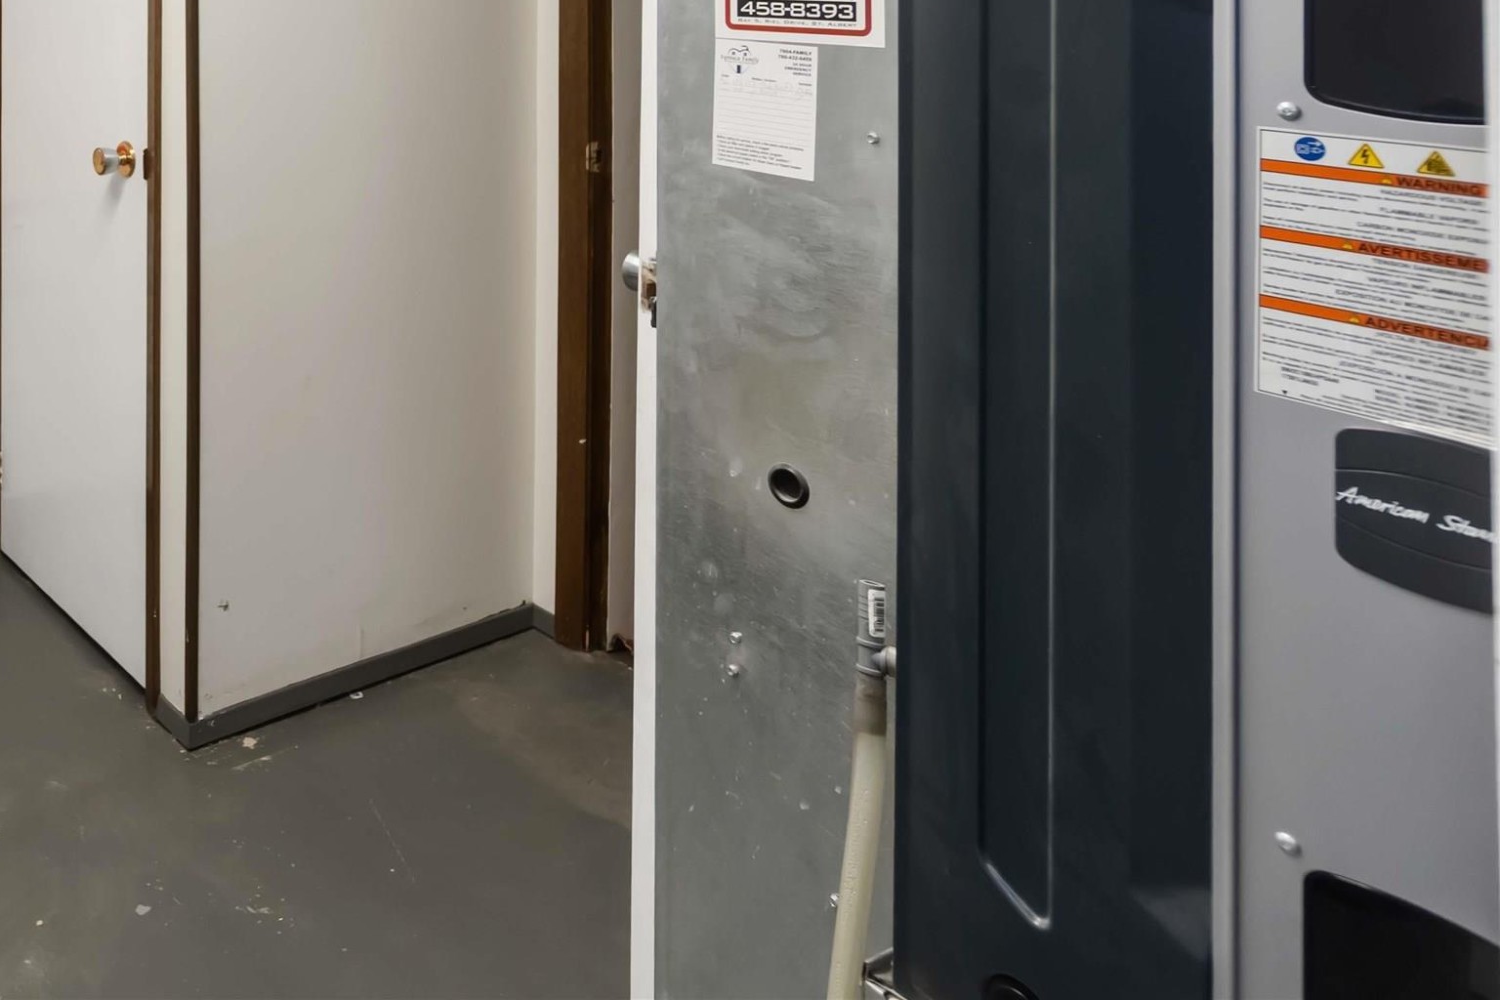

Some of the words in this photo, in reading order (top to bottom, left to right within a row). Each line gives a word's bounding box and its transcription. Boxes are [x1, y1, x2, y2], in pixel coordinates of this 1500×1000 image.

[739, 1, 855, 20] 458-8393
[1396, 175, 1484, 197] WARNING
[1336, 486, 1431, 525] American
